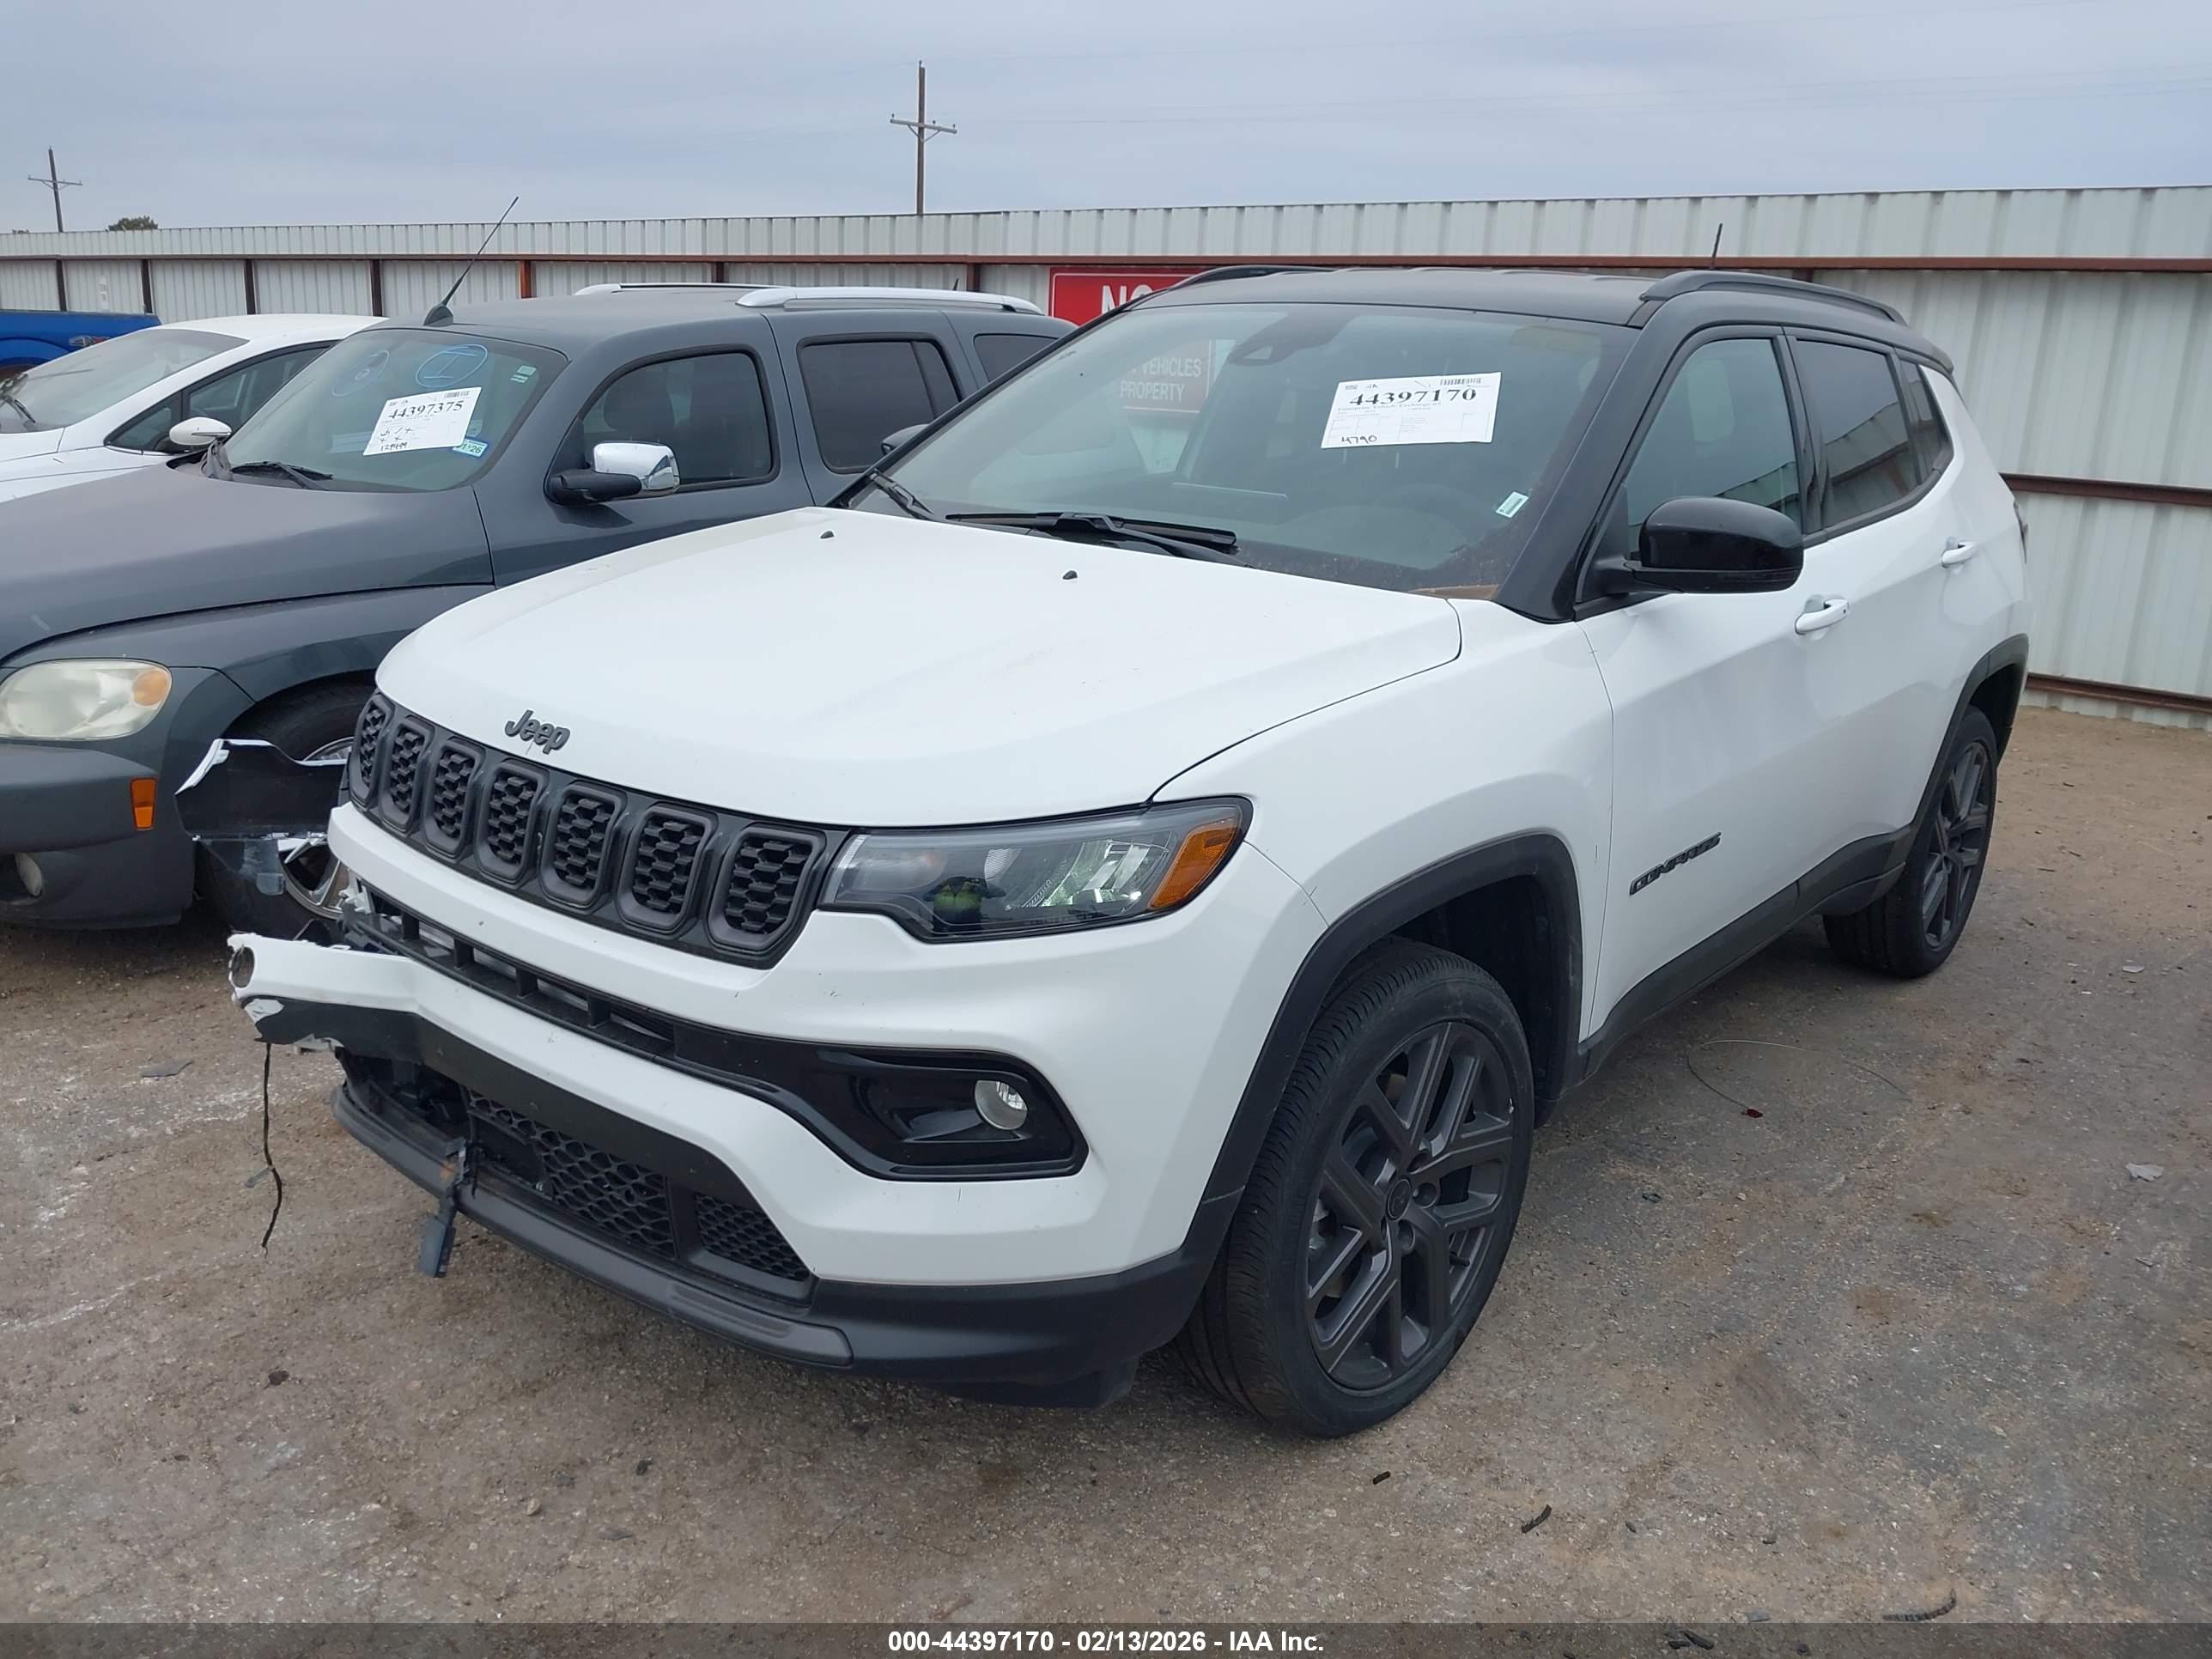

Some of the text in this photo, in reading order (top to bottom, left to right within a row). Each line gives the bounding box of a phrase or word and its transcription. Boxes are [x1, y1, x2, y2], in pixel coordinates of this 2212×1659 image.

[1142, 357, 1202, 378] VEHICLES
[1120, 380, 1186, 402] PROPERTY
[1349, 387, 1477, 406] 44397170
[388, 399, 465, 419] 44397375
[504, 709, 571, 756] Jeep
